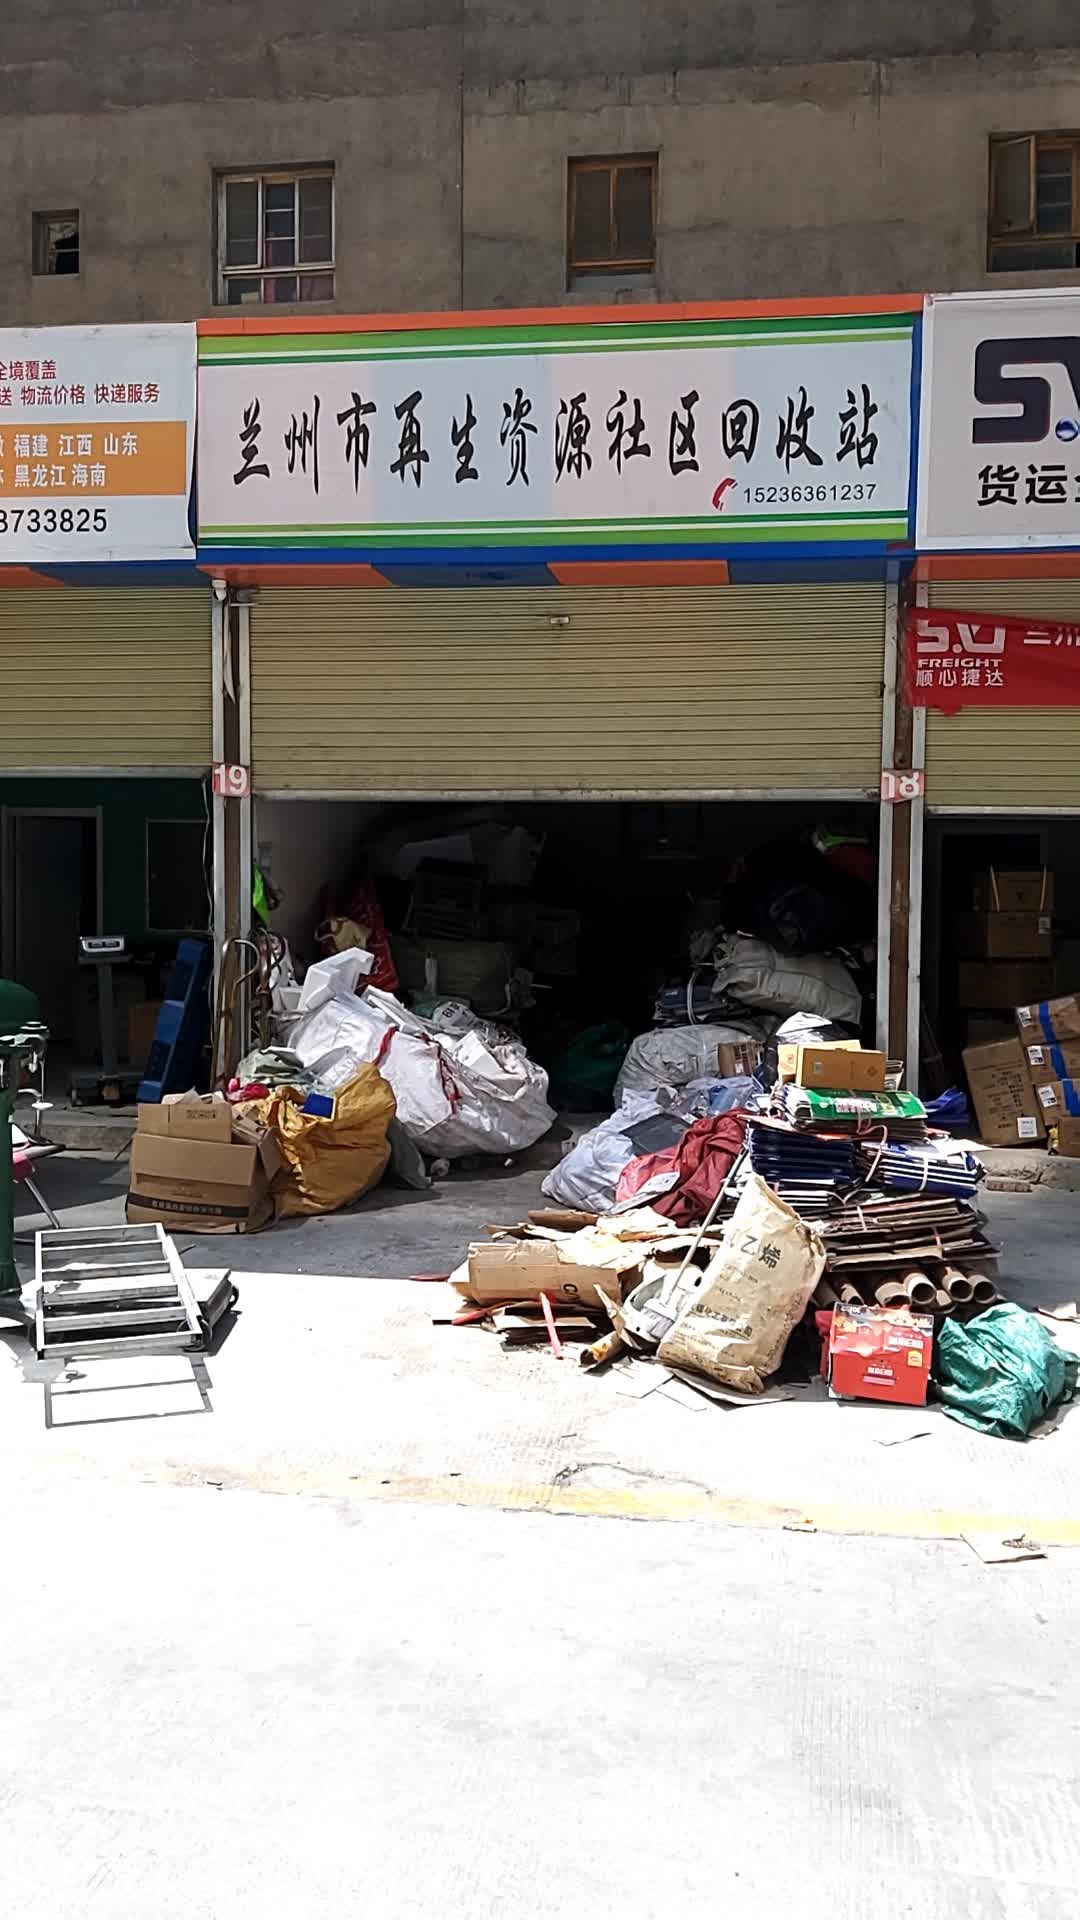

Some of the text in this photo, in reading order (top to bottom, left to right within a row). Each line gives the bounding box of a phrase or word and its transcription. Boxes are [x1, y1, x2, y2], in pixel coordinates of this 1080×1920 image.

[20, 384, 85, 406] 物流价格
[94, 382, 160, 404] 快递服务
[14, 433, 49, 458] 福建
[58, 433, 92, 457] 江西
[104, 431, 138, 456] 山东
[233, 383, 879, 495] 兰州市再生资源社区回收站
[14, 464, 66, 487] 黑龙江
[72, 463, 107, 487] 海南
[743, 482, 877, 504] 15236361237
[917, 658, 1003, 668] FREIGHT
[915, 669, 1004, 687] 顺心捷达
[214, 764, 248, 794] 19
[882, 771, 920, 799] 18
